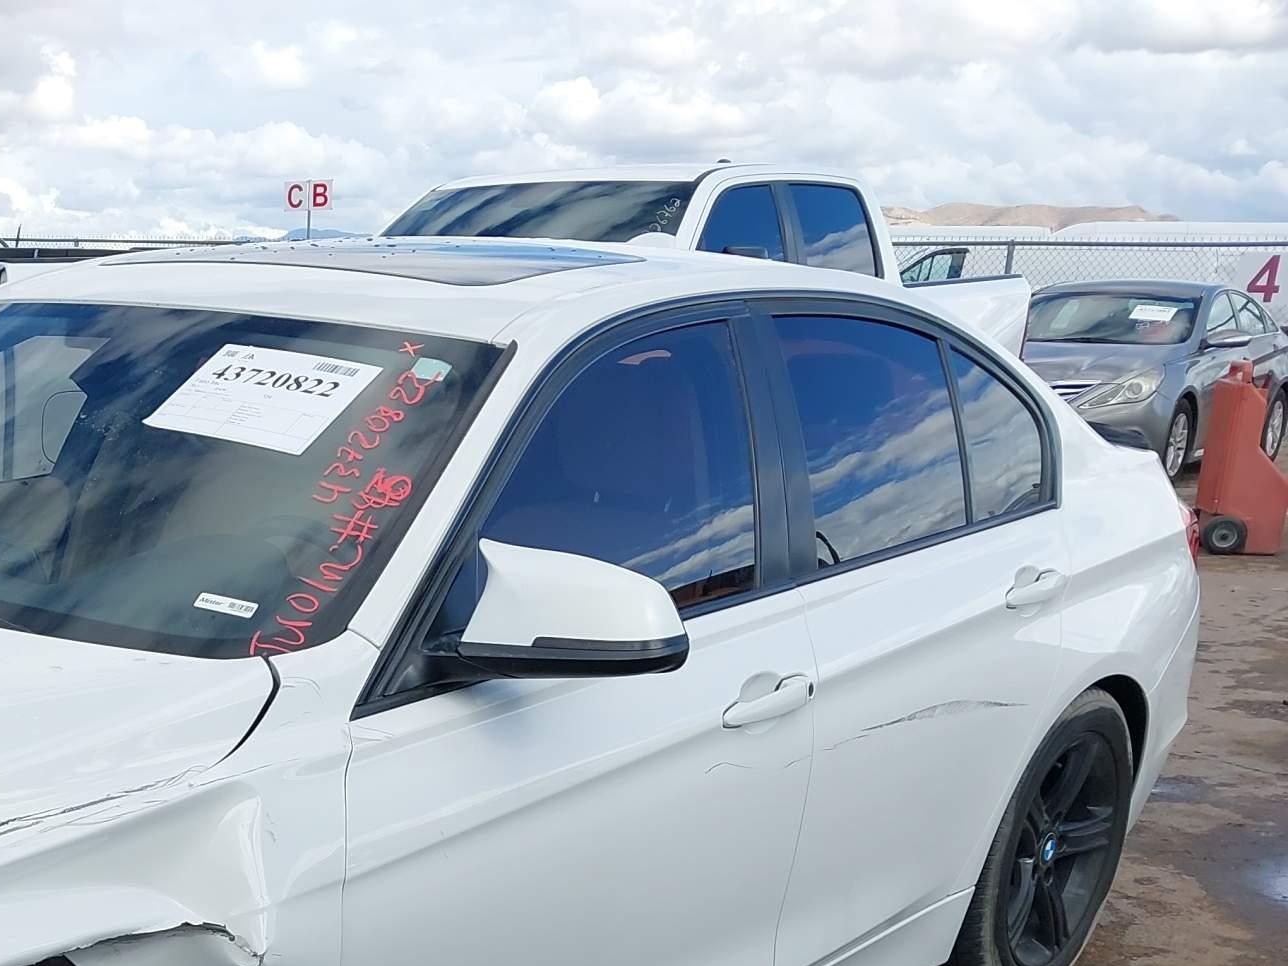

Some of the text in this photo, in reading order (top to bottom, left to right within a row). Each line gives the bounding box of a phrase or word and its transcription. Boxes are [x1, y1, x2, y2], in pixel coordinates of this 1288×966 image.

[287, 182, 329, 209] C B
[1246, 254, 1281, 303] 4
[212, 364, 341, 398] 43720822
